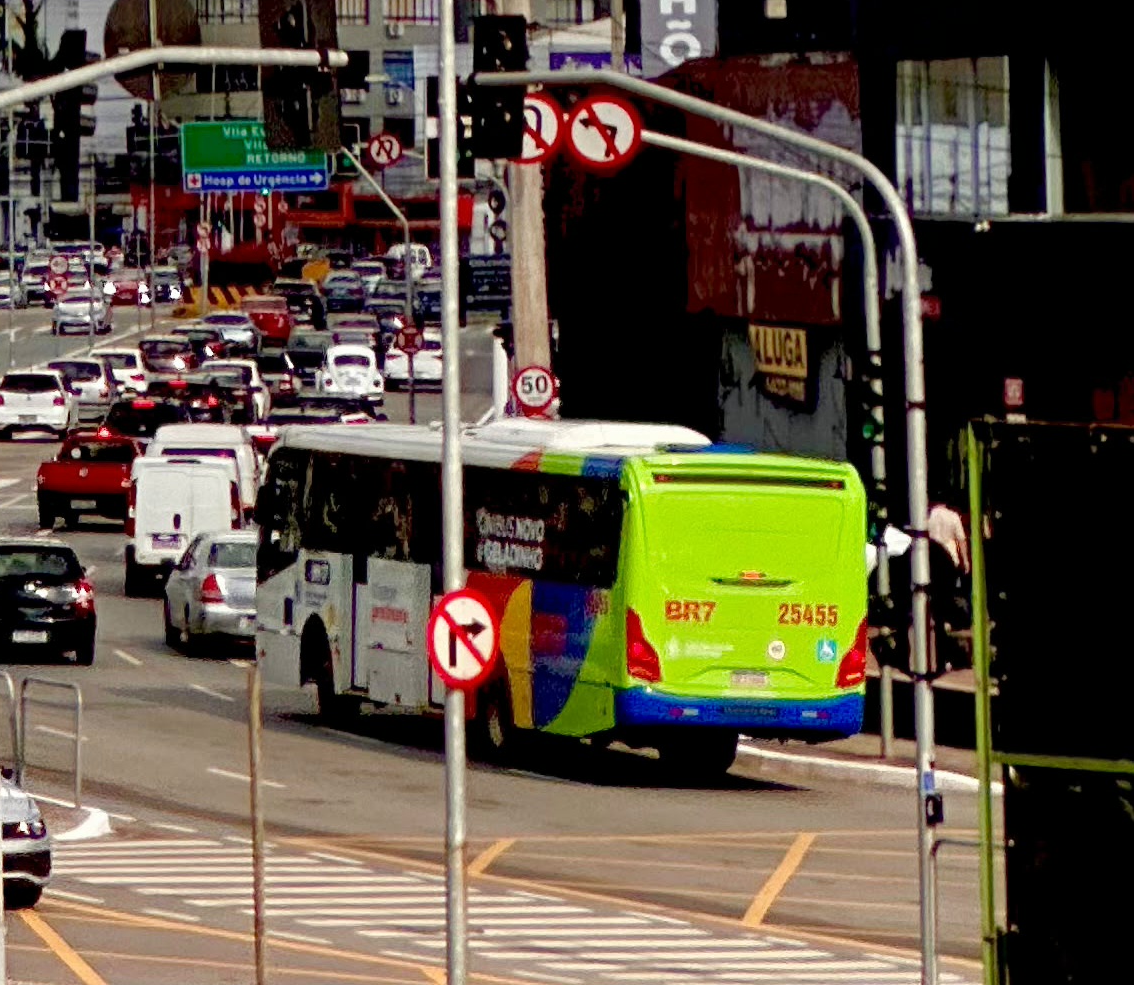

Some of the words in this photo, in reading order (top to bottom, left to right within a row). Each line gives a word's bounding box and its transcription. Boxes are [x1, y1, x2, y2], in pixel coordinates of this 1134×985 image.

[247, 152, 305, 164] RETORNO
[238, 175, 251, 185] de
[254, 173, 307, 188] Urgência
[521, 375, 549, 395] 50
[515, 517, 545, 543] NOVO
[664, 600, 716, 623] BR7
[777, 602, 839, 628] 25455
